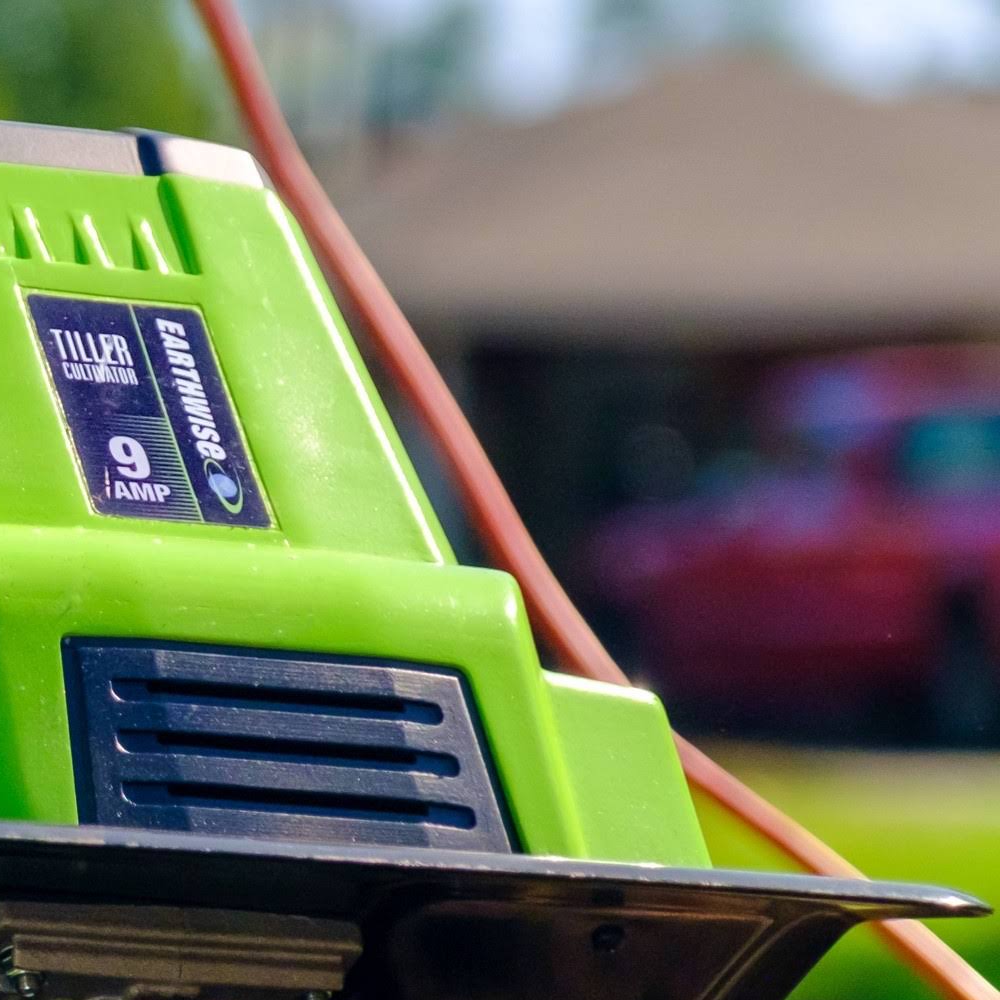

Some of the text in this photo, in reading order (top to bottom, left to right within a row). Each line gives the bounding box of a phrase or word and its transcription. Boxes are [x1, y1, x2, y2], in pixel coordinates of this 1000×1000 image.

[50, 328, 134, 366] TILLER
[62, 361, 138, 385] CULTIVATOR
[108, 436, 150, 479] 9
[115, 482, 171, 503] AMP
